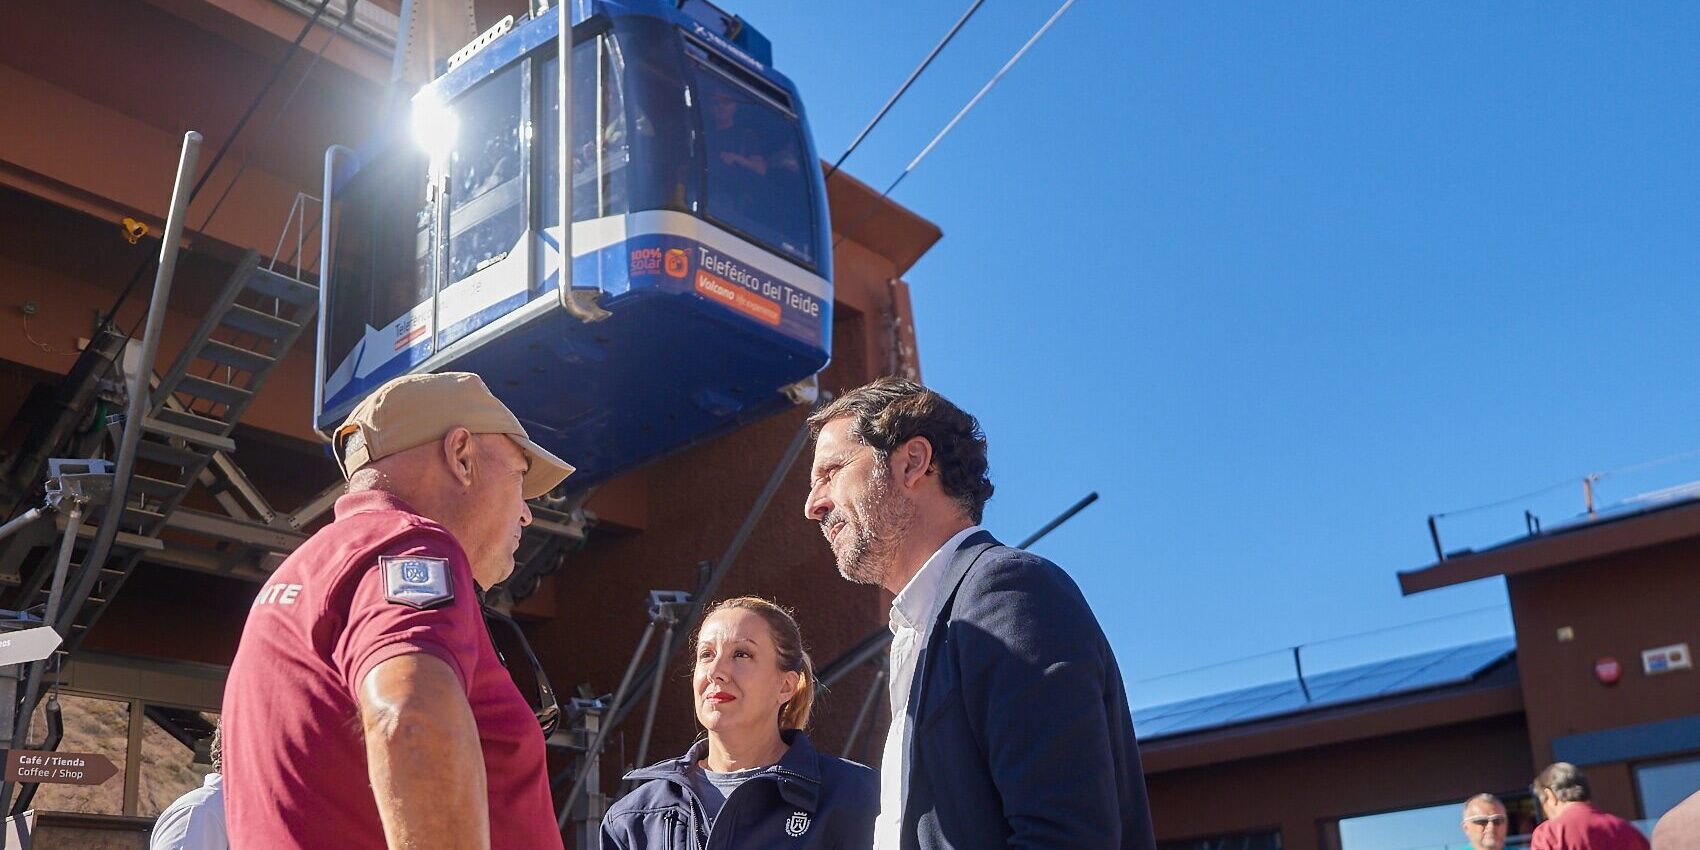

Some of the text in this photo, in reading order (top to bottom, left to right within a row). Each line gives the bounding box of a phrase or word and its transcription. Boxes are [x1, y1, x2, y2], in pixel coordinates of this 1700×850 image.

[631, 248, 661, 261] 100%
[699, 247, 760, 290] Teleférico
[762, 281, 781, 301] del
[784, 286, 819, 317] Teide
[699, 274, 735, 300] Volcano
[19, 755, 85, 767] Café / Tienda
[18, 767, 83, 780] Coffee / Shop
